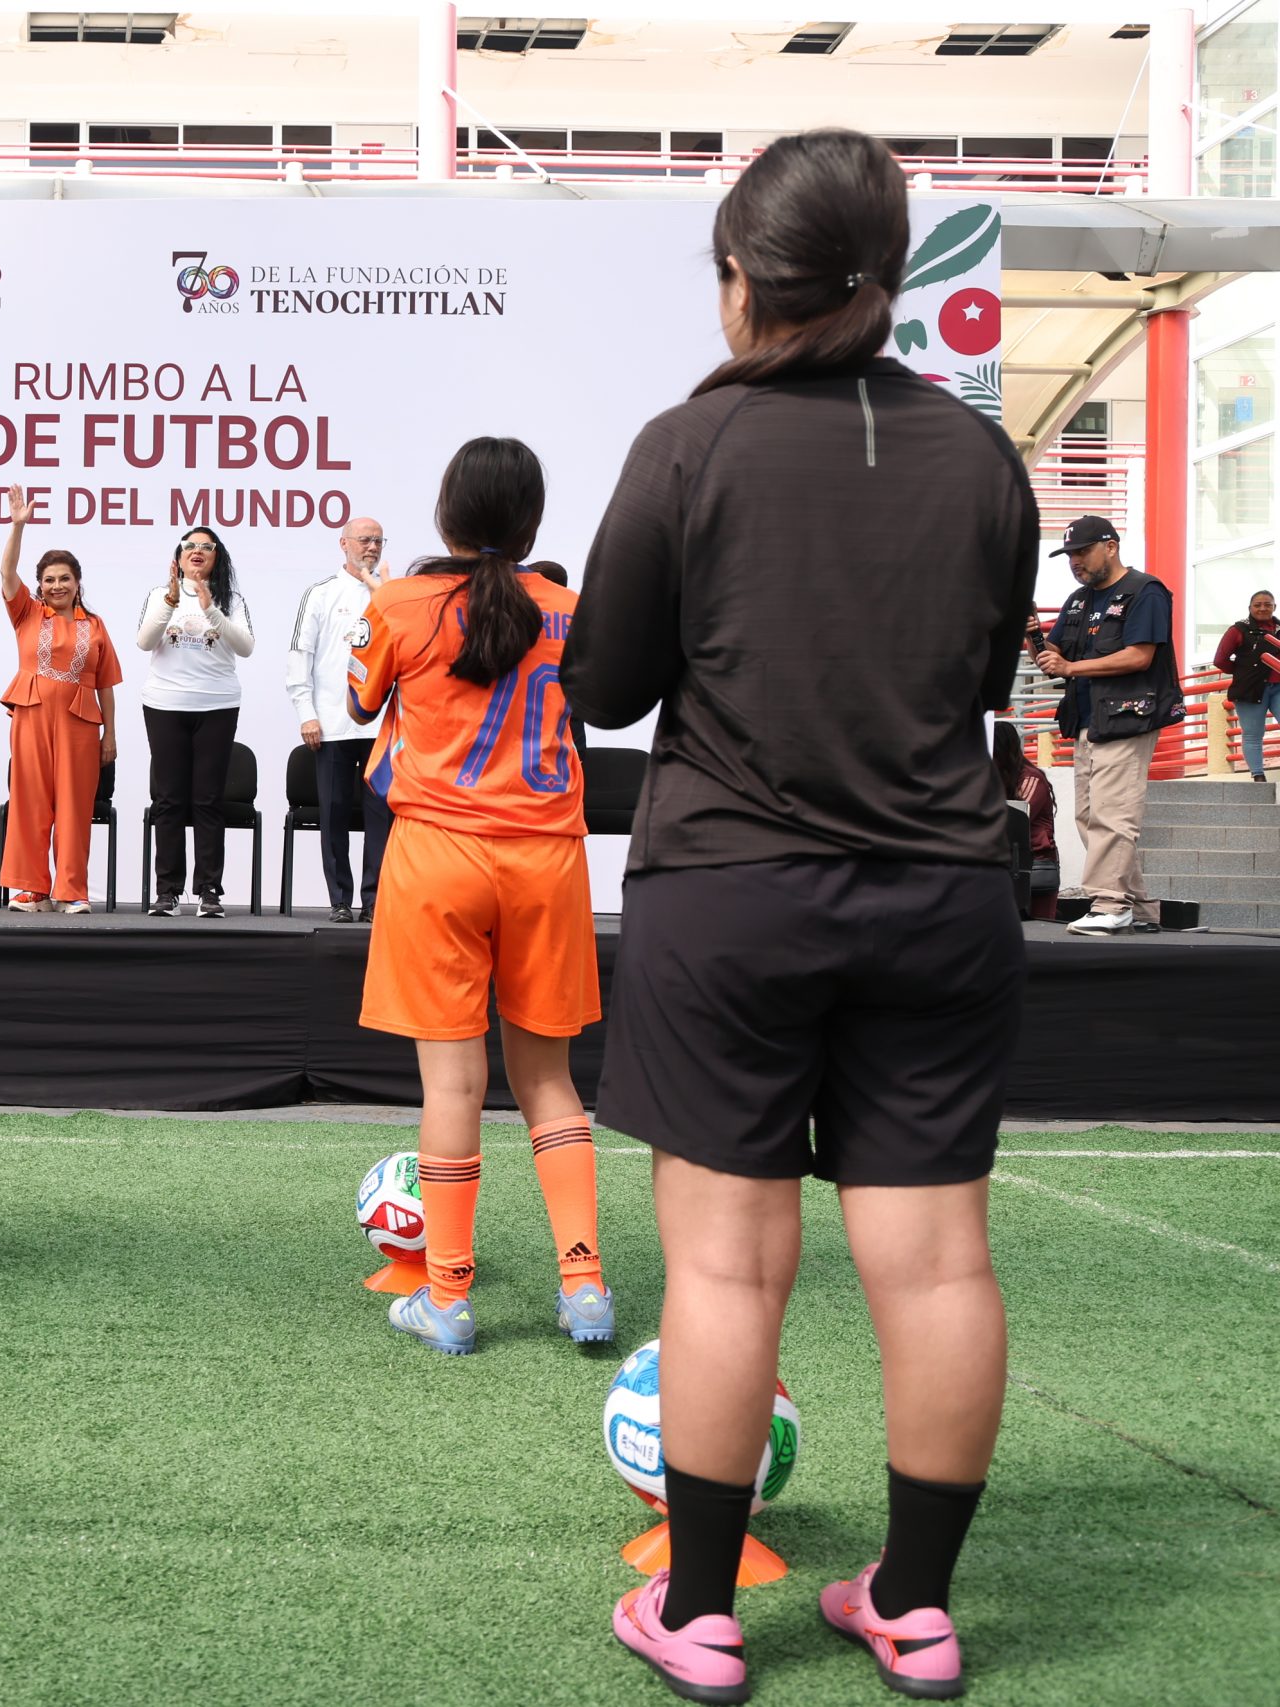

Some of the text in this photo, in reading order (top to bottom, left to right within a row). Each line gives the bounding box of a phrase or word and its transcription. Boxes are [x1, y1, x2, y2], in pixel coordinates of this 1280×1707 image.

[250, 264, 508, 285] DE LA FUNDACIÓN DE
[197, 299, 240, 314] AÑOS
[250, 290, 507, 316] TENOCHTITLAN
[14, 362, 185, 402] RUMBO
[200, 363, 233, 402] A
[249, 363, 308, 403] LA
[83, 414, 352, 471] FUTBOL
[67, 486, 154, 526] DEL
[170, 488, 351, 528] MUNDO
